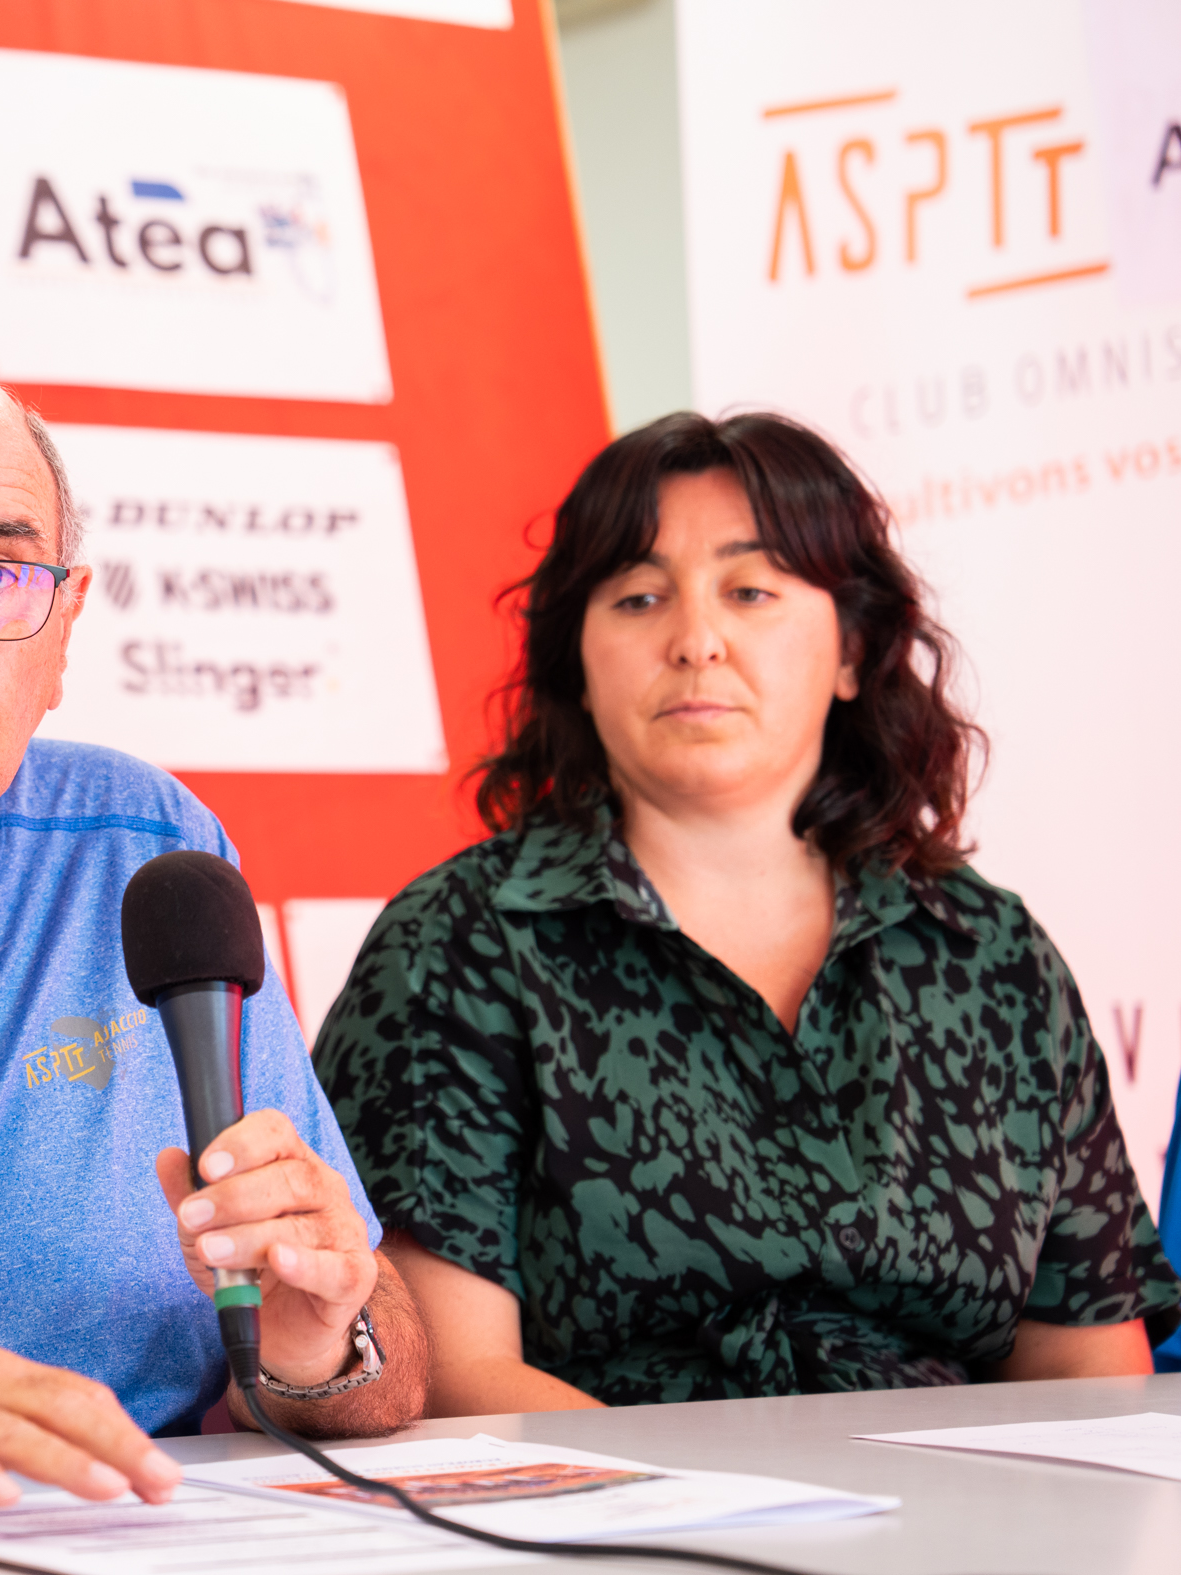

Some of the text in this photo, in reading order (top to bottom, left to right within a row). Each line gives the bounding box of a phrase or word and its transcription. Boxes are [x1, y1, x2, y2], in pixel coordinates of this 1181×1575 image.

[16, 176, 252, 275] Atea
[765, 107, 1086, 284] ASPTT
[849, 362, 991, 441] CLUB
[107, 499, 361, 536] DUNLOP
[120, 638, 319, 713] Slinger
[93, 1008, 147, 1047] AJACCIO
[97, 1033, 139, 1063] TENNIS
[25, 1042, 85, 1089] ASPTT
